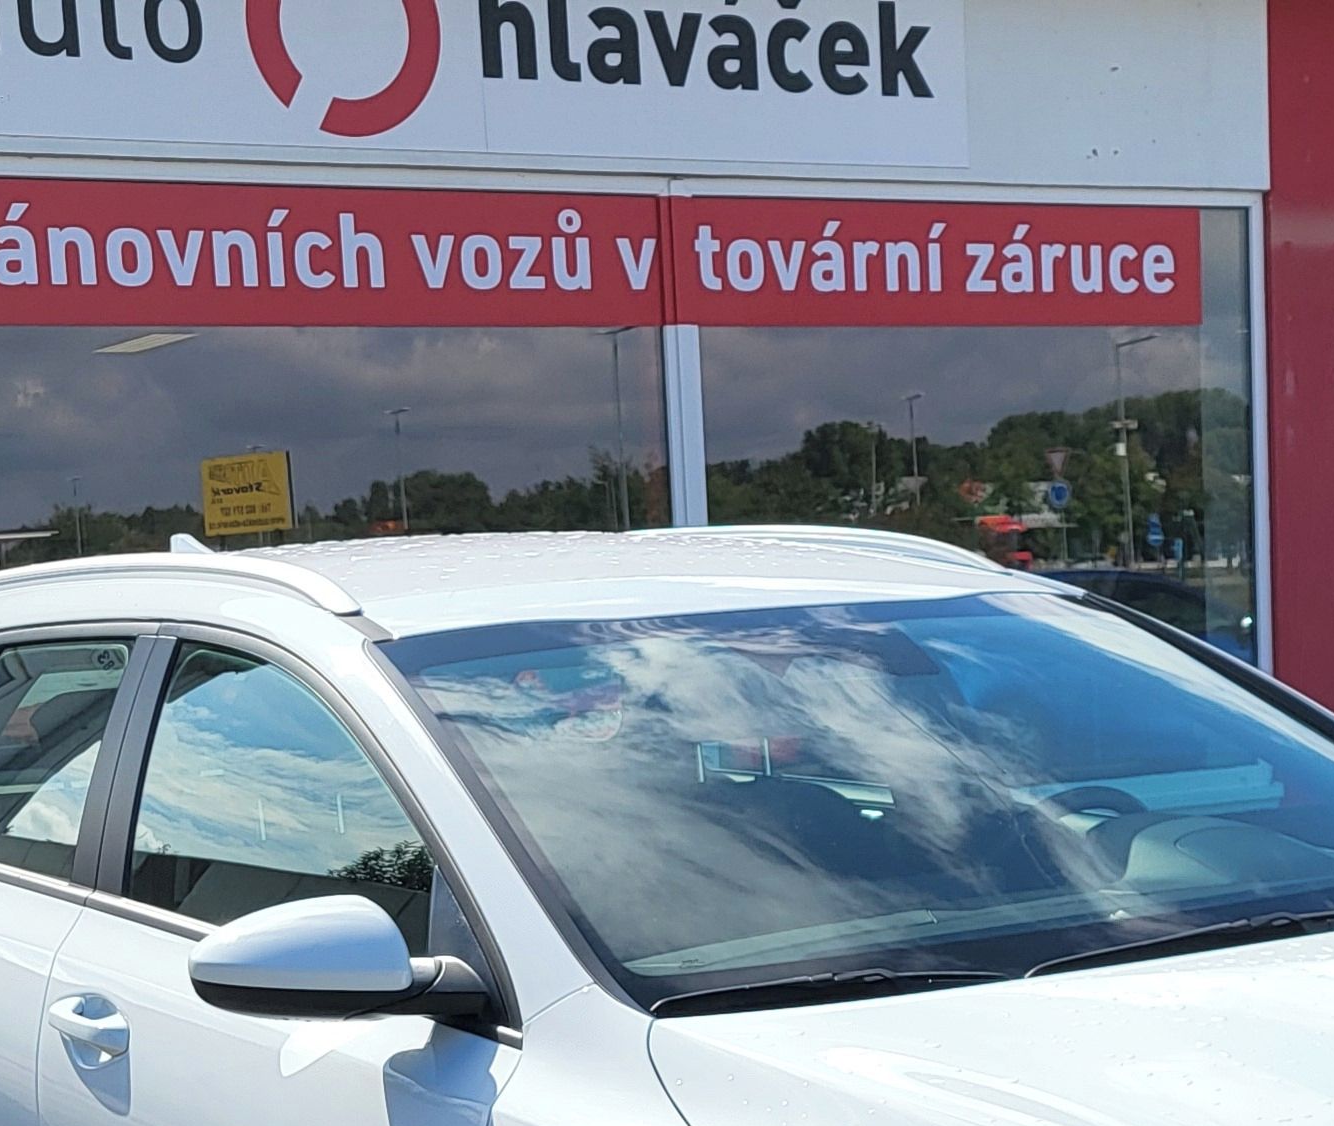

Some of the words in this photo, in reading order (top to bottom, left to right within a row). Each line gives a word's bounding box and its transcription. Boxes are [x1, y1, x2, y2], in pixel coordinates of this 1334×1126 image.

[410, 208, 593, 291] vozů
[615, 237, 657, 290] v
[694, 220, 947, 292] tovární
[966, 223, 1175, 294] záruce
